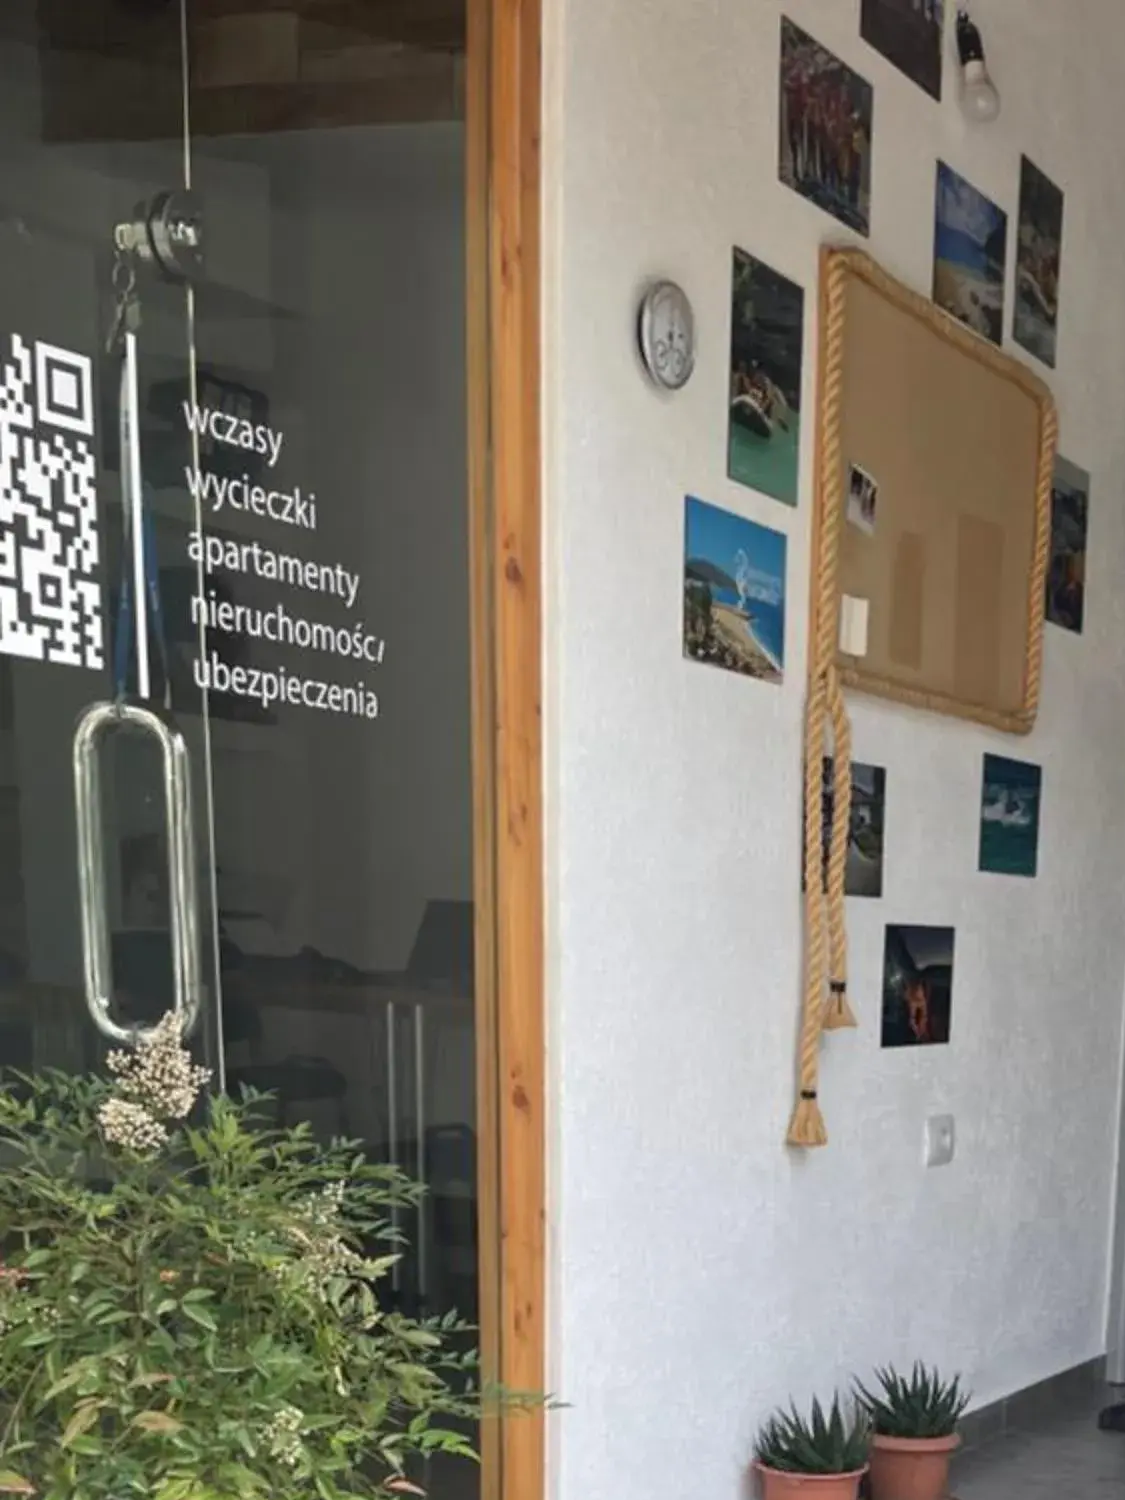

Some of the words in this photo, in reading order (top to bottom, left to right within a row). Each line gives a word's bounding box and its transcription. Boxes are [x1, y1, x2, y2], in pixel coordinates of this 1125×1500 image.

[182, 399, 284, 468] wczasy
[185, 464, 316, 530] wycieczki
[187, 529, 360, 609] apartamenty
[193, 652, 378, 719] ubezpieczenia
